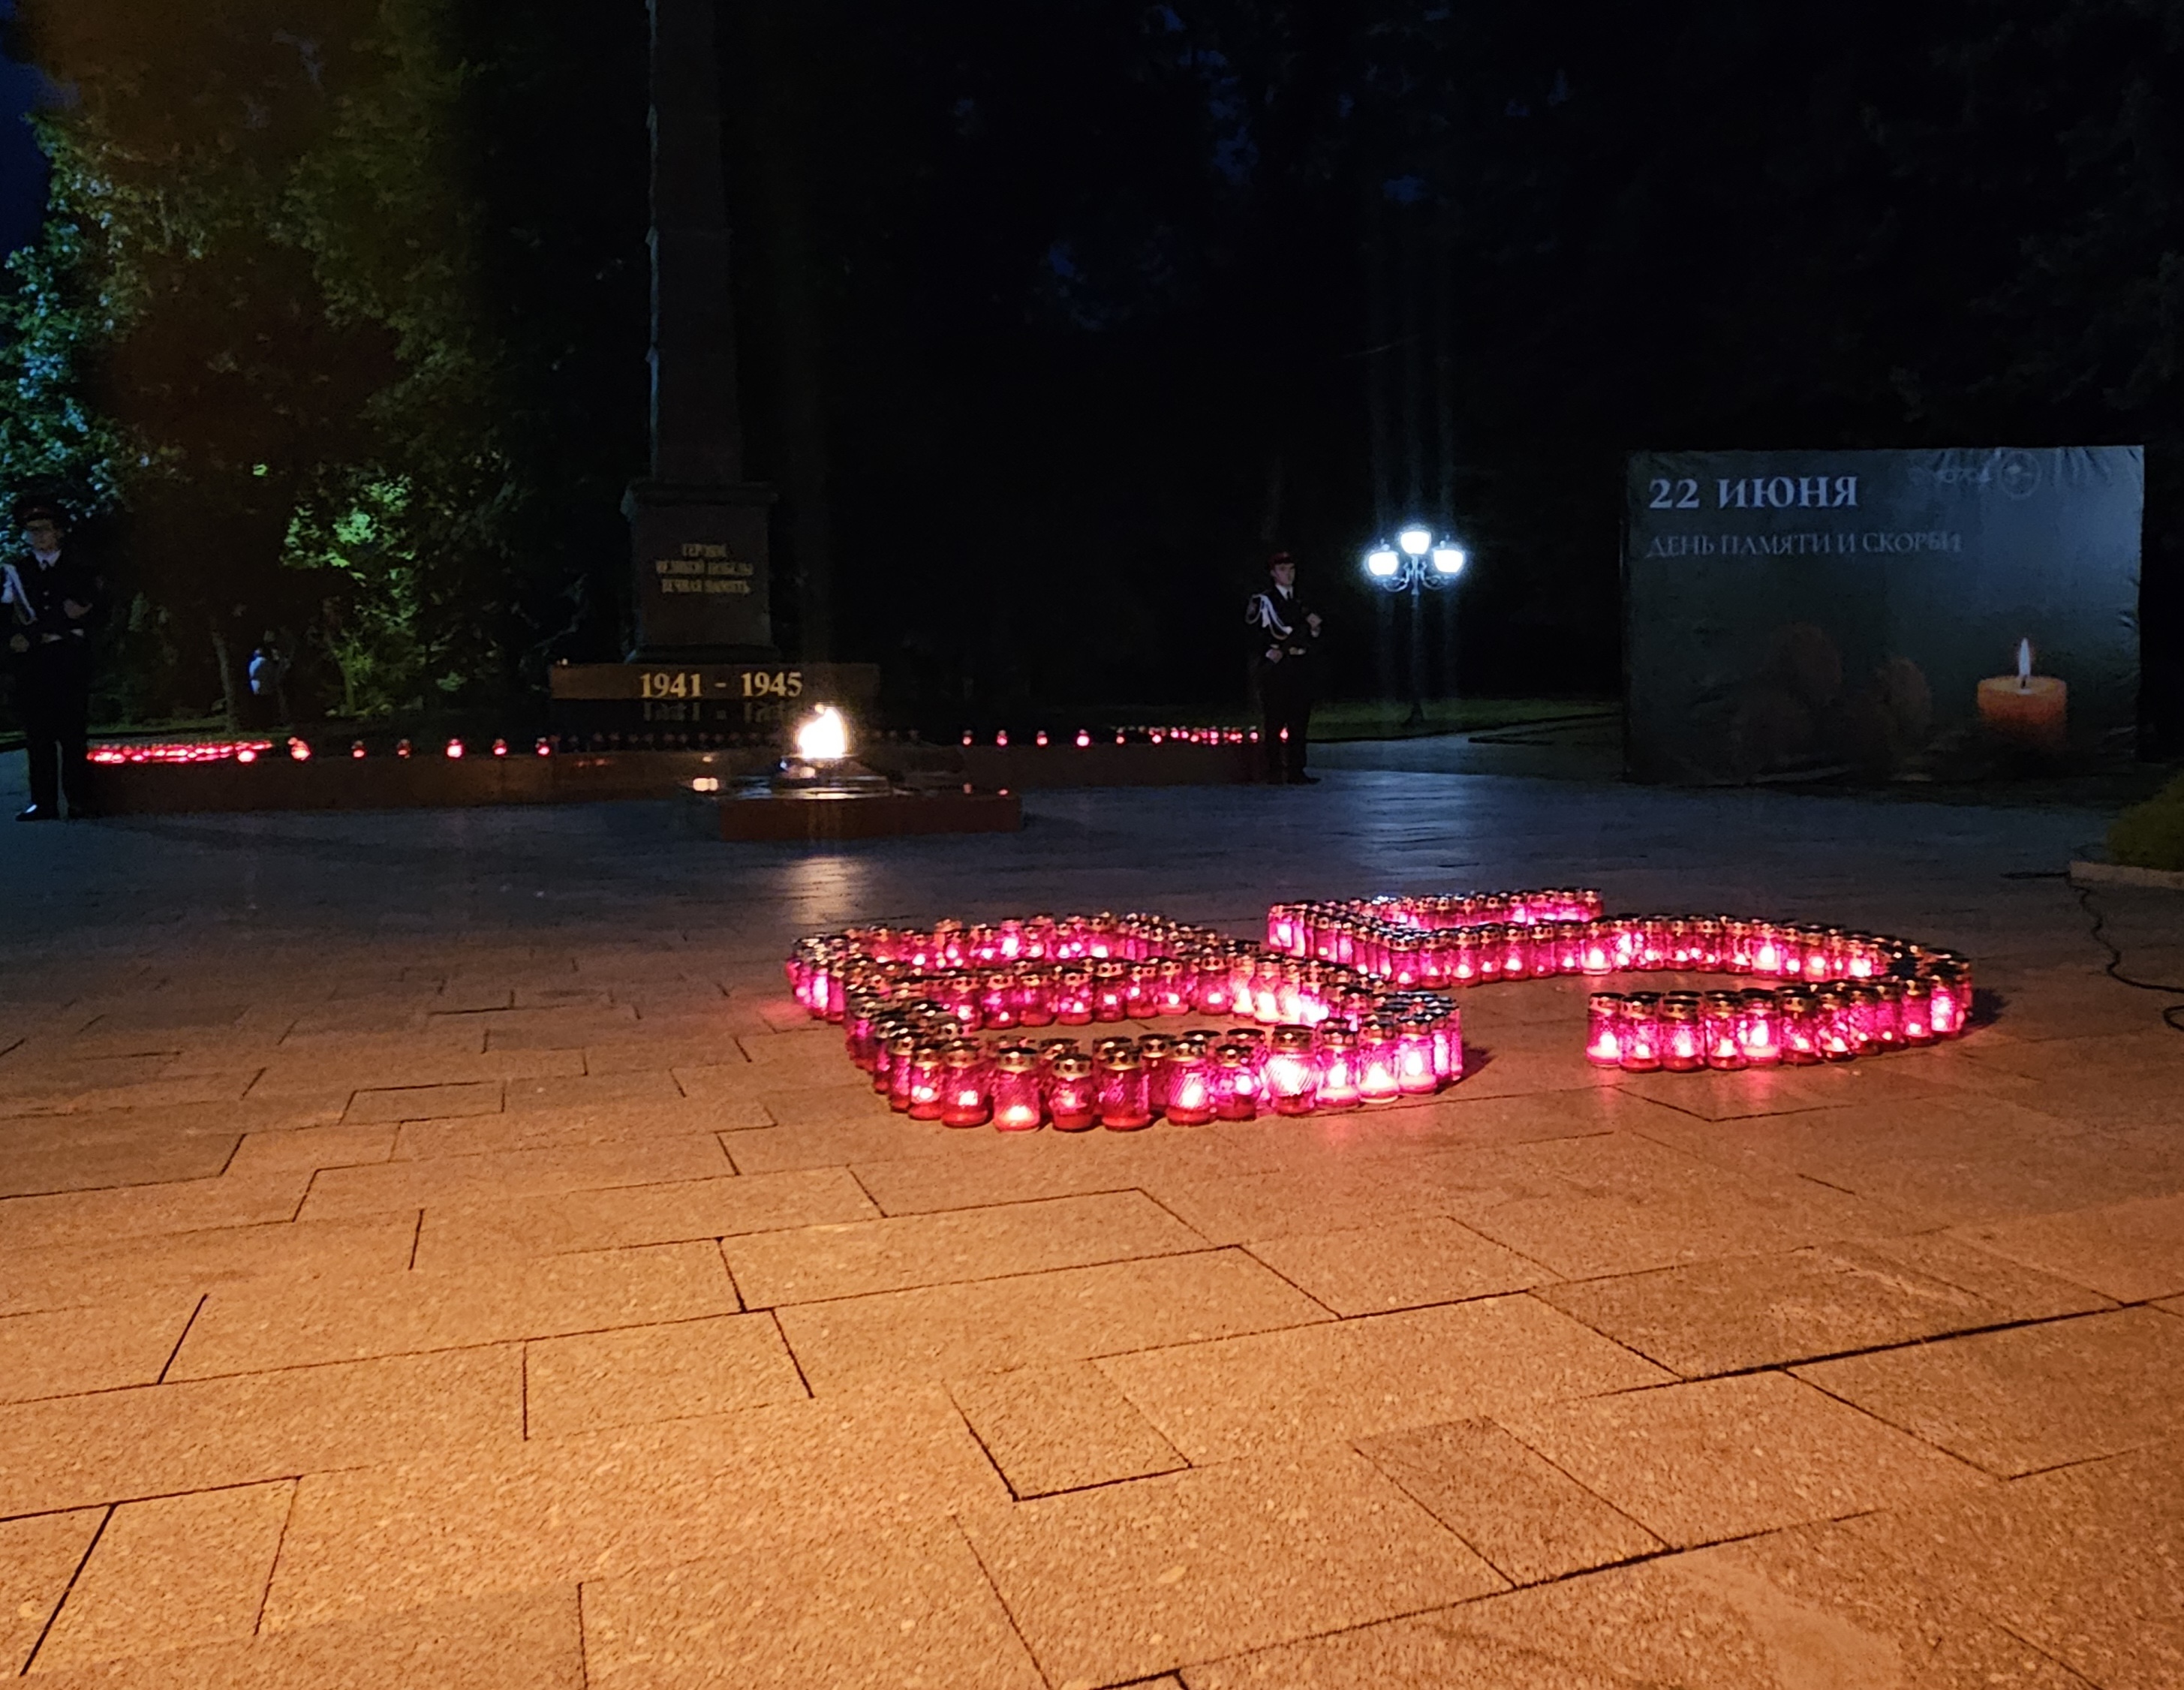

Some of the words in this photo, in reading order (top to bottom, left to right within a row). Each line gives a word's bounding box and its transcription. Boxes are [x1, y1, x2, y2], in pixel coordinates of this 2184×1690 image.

[1649, 478, 1700, 509] 22
[1716, 476, 1859, 509] ИЮНЯ
[1644, 534, 1714, 558] ДЕНЬ
[1721, 533, 1830, 555] ПАМЯТИ
[1837, 532, 1856, 554] И
[1863, 531, 1961, 554] СКОРБИ
[640, 672, 702, 698] 1941
[741, 671, 802, 698] 1945
